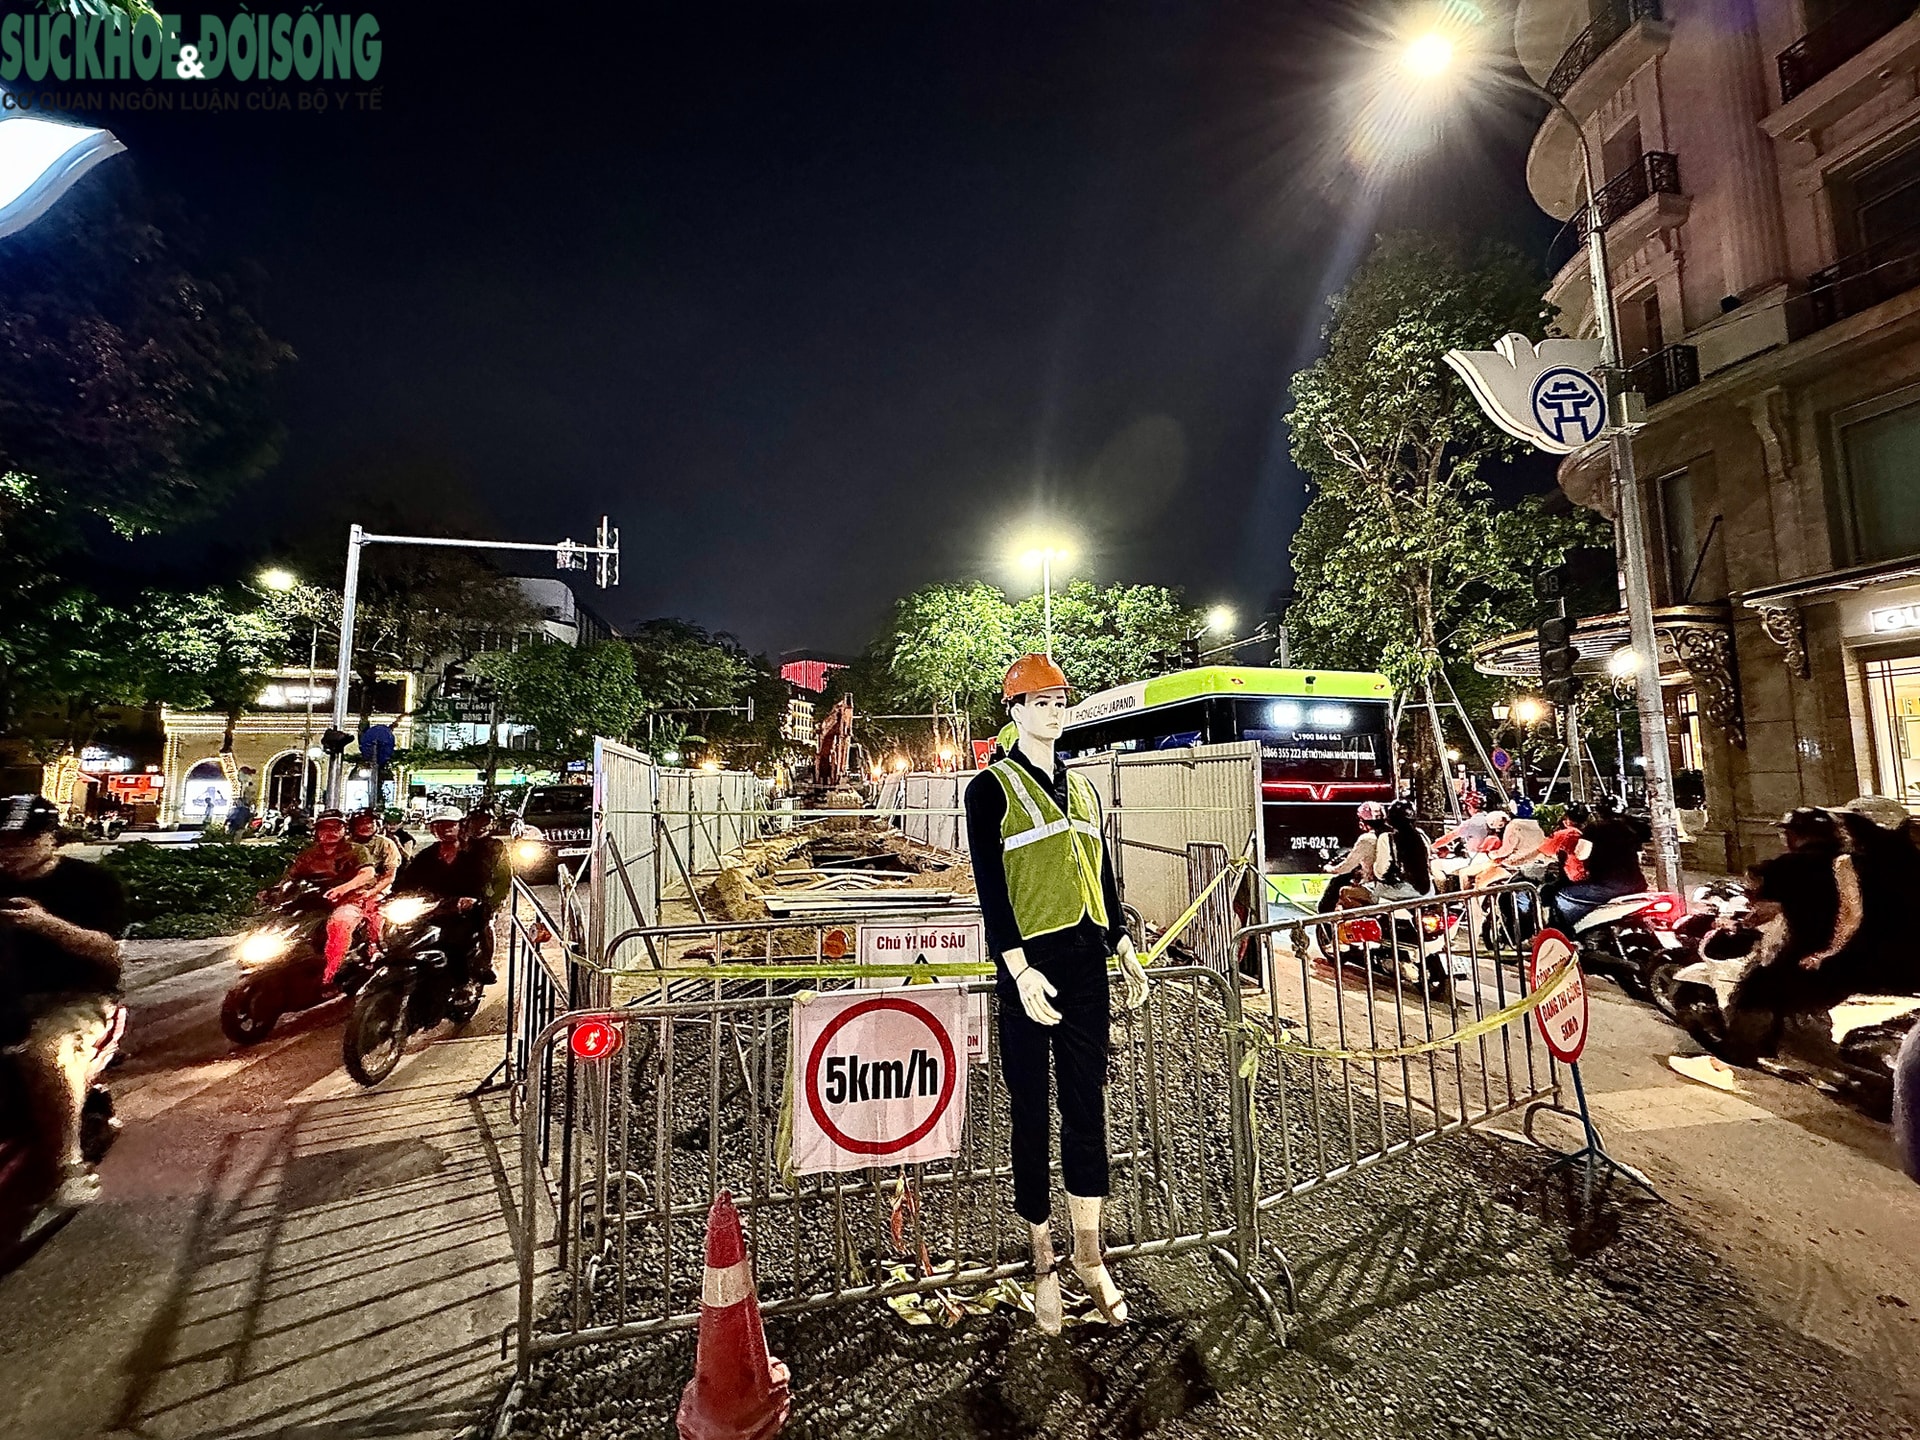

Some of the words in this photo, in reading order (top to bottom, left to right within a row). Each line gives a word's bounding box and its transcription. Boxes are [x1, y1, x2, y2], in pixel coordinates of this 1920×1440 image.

[1290, 748, 1302, 759] 222
[876, 935, 901, 950] Chú
[941, 932, 966, 949] SÂU
[825, 1048, 938, 1105] 5km/h
